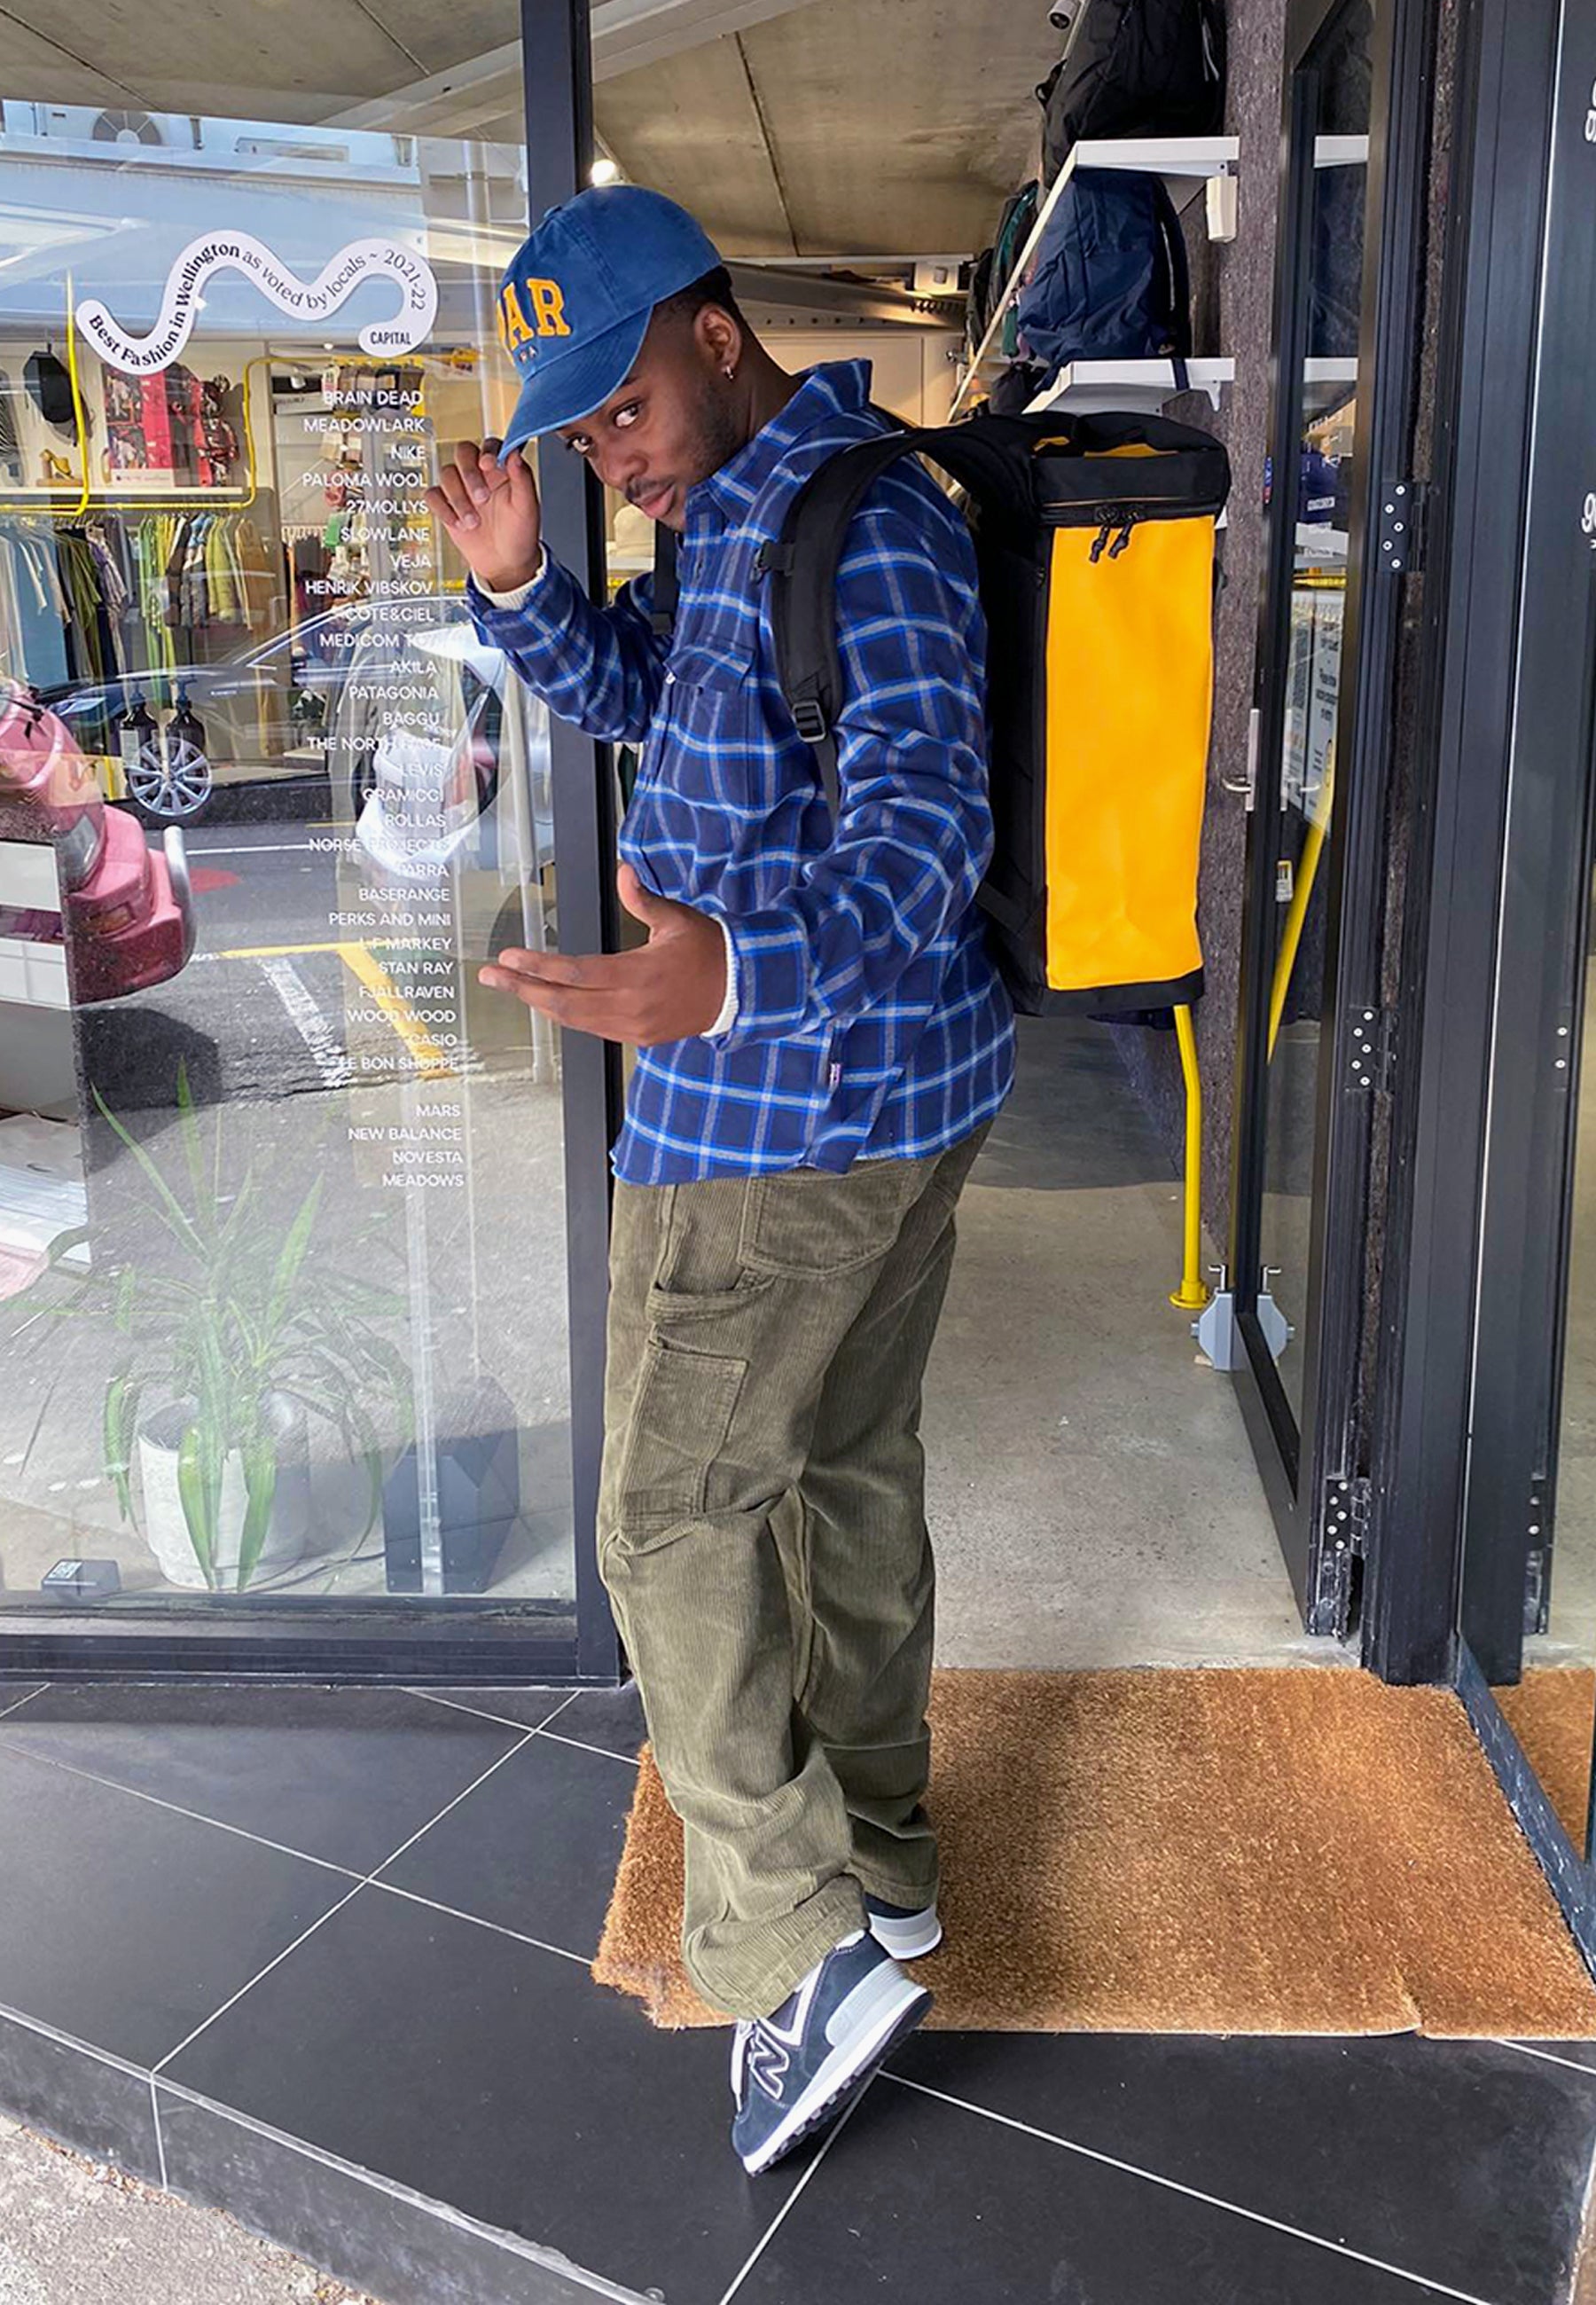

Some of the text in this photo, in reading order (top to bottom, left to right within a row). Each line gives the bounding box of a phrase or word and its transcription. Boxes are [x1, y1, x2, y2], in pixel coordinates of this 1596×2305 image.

[241, 250, 263, 270] as
[176, 243, 240, 307] Wellington
[328, 255, 367, 299] locals
[383, 248, 426, 311] 2021-22
[262, 269, 304, 309] voted
[305, 291, 329, 310] by
[172, 310, 187, 329] in
[89, 314, 121, 355] Best
[370, 331, 412, 346] CAPITAL
[121, 326, 182, 368] Fashion
[324, 390, 424, 405] BRAIN DEAD
[303, 418, 426, 433] MEADOWLARK
[390, 445, 426, 459] NIKE
[302, 473, 428, 488] PALOMA WOOL
[347, 500, 429, 514] 27MOLLYS
[340, 527, 431, 541] SLOWLANE
[390, 553, 432, 568] VEJA
[305, 581, 434, 595] HENRIK VIBSKOV
[319, 633, 399, 647] MEDICOM
[390, 660, 437, 674] AKILA
[349, 686, 439, 700] PATAGONIA
[383, 711, 440, 725] BAGGU
[307, 737, 338, 751] THE
[342, 737, 395, 751] NORTH
[363, 788, 443, 803] GRAMICCI
[385, 813, 446, 827] ROLLAS
[309, 838, 362, 852] NORSE
[358, 888, 450, 902] BASERANGE
[329, 913, 451, 926] PERKS AND MINI
[387, 937, 452, 950] MARKEY
[379, 961, 455, 975] STAN RAY
[347, 1010, 457, 1023] WOOD WOOD
[409, 1033, 458, 1047] CASIO
[361, 1056, 395, 1070] BON
[416, 1105, 461, 1117] MARS
[348, 1128, 462, 1141] NEW BALANCE
[392, 1151, 464, 1164] NOVESTA
[382, 1174, 464, 1187] MEADOWS
